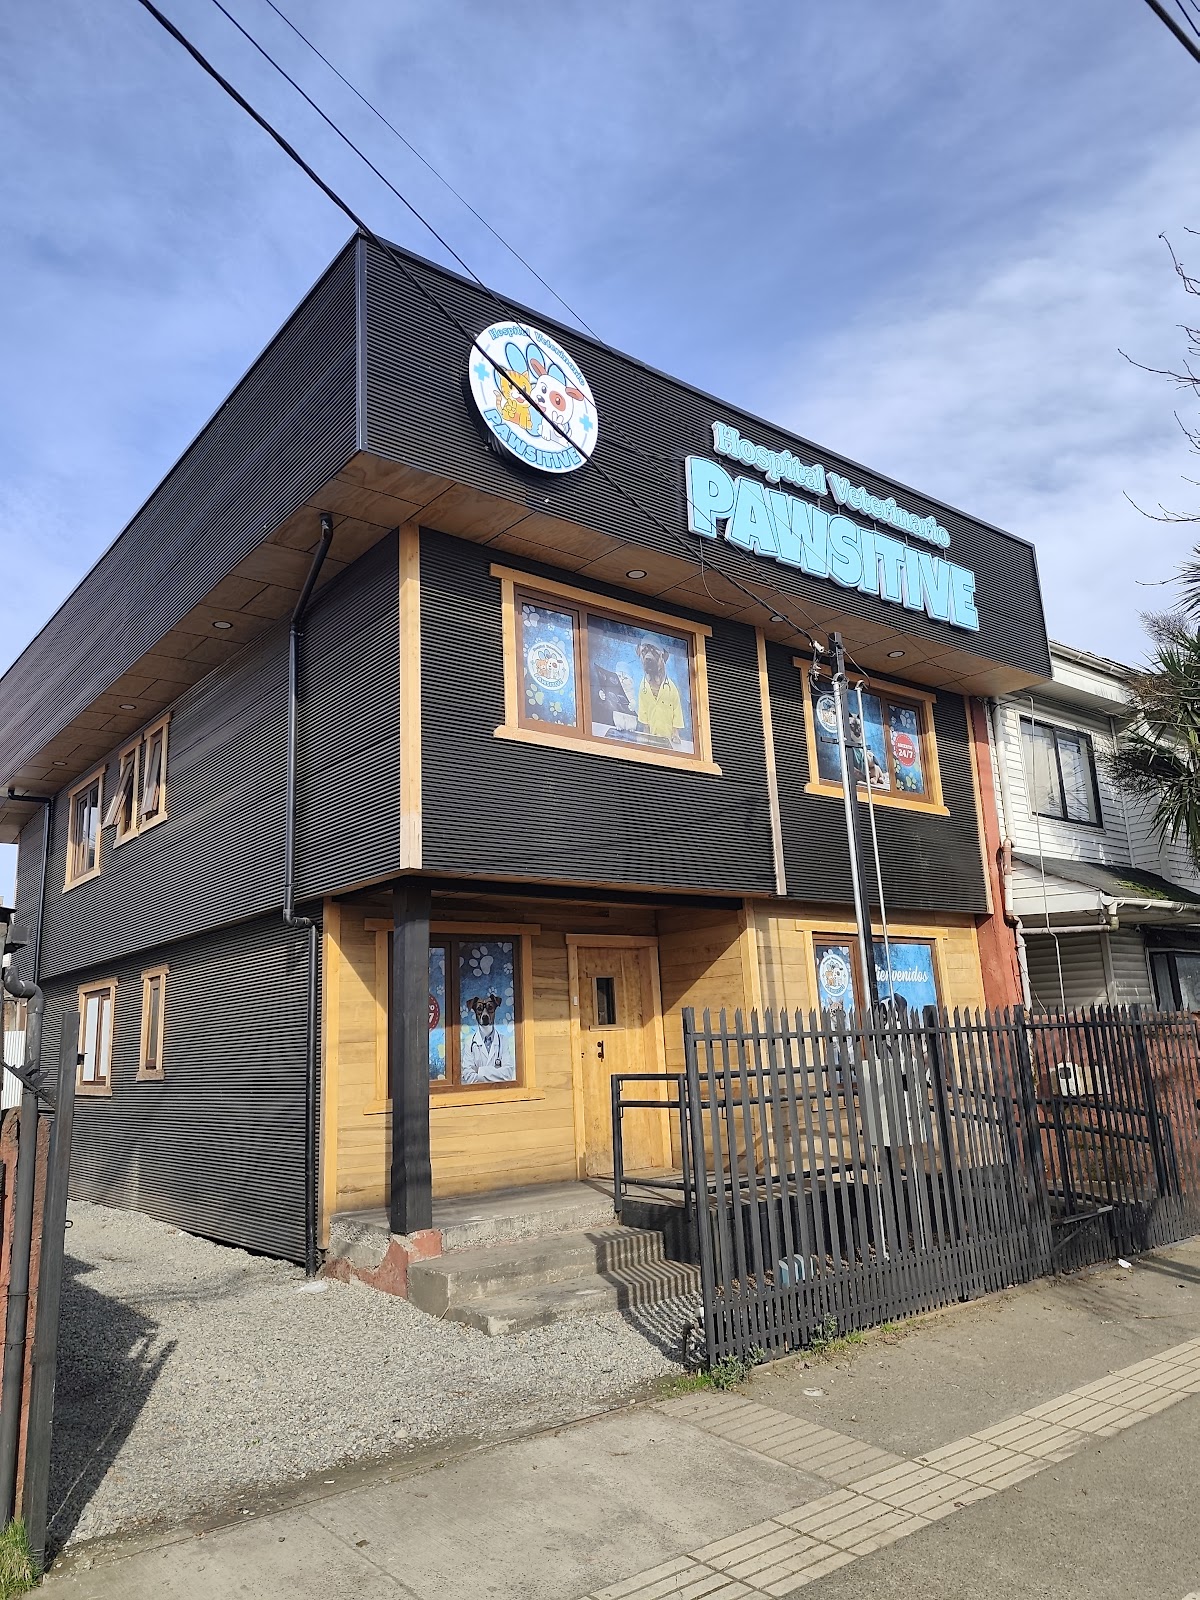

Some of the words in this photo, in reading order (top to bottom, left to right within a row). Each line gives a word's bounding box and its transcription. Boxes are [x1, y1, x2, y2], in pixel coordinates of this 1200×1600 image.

[488, 326, 531, 341] Hospital
[534, 330, 586, 387] Veterinario
[484, 409, 582, 469] PAWSITIVE
[711, 420, 828, 496] Hospital
[826, 471, 951, 549] Veterinario
[684, 455, 979, 631] PAWSITIVE
[898, 748, 913, 759] 24/7
[875, 963, 929, 983] ievenidos
